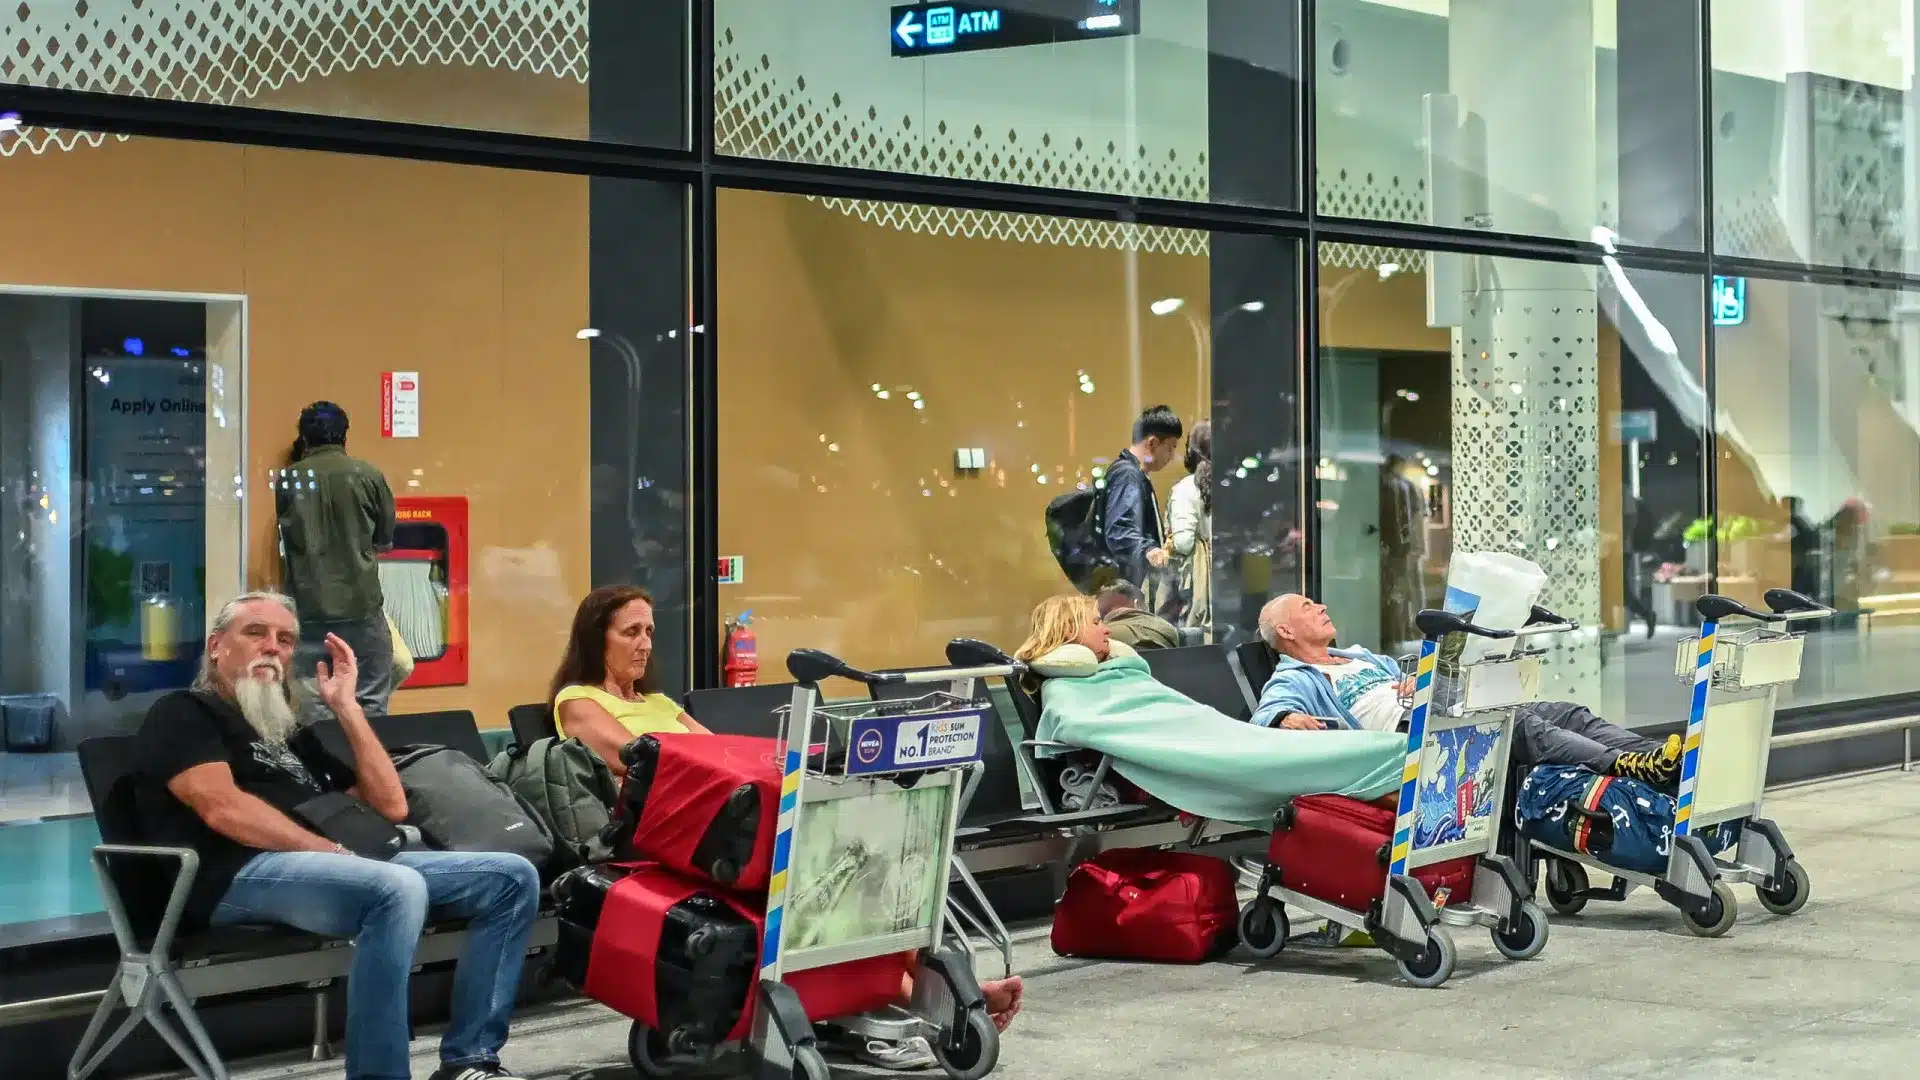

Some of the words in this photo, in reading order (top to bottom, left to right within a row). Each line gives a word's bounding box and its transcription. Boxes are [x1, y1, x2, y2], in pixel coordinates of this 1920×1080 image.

[931, 15, 950, 25] ATM
[958, 11, 999, 33] ATM
[110, 398, 156, 415] Apply
[950, 722, 965, 732] SUN
[929, 731, 975, 744] PROTECTION
[861, 740, 880, 748] NIVEA
